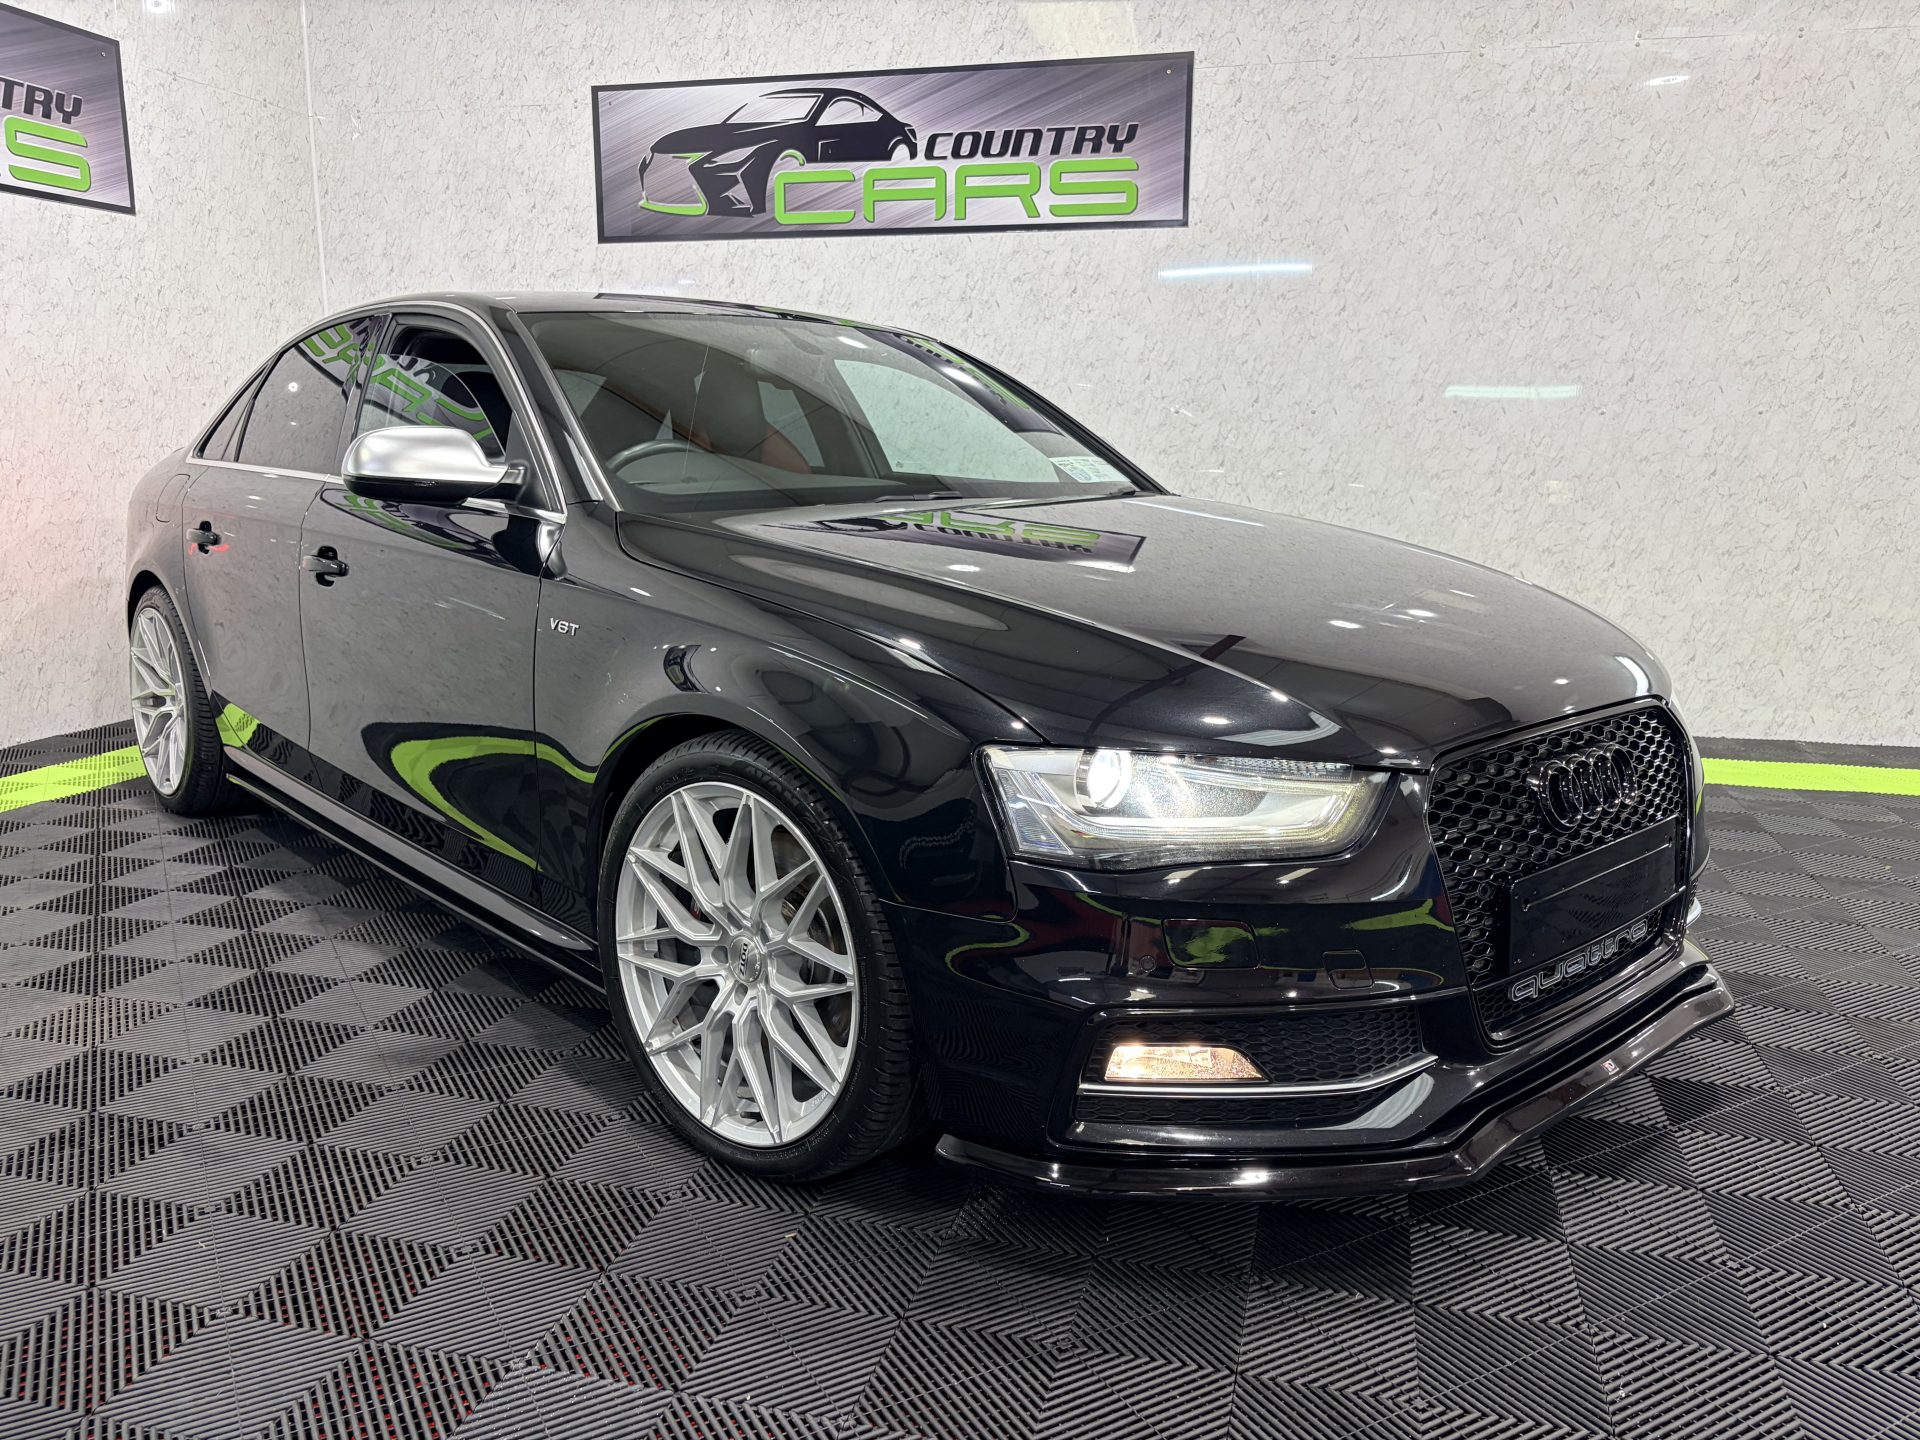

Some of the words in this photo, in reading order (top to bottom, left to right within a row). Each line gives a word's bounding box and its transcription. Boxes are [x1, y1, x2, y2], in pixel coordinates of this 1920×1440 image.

[924, 123, 1139, 160] COUNTRY
[774, 157, 1139, 225] CARS
[550, 617, 580, 636] V6T
[1508, 918, 1648, 1001] quattro
